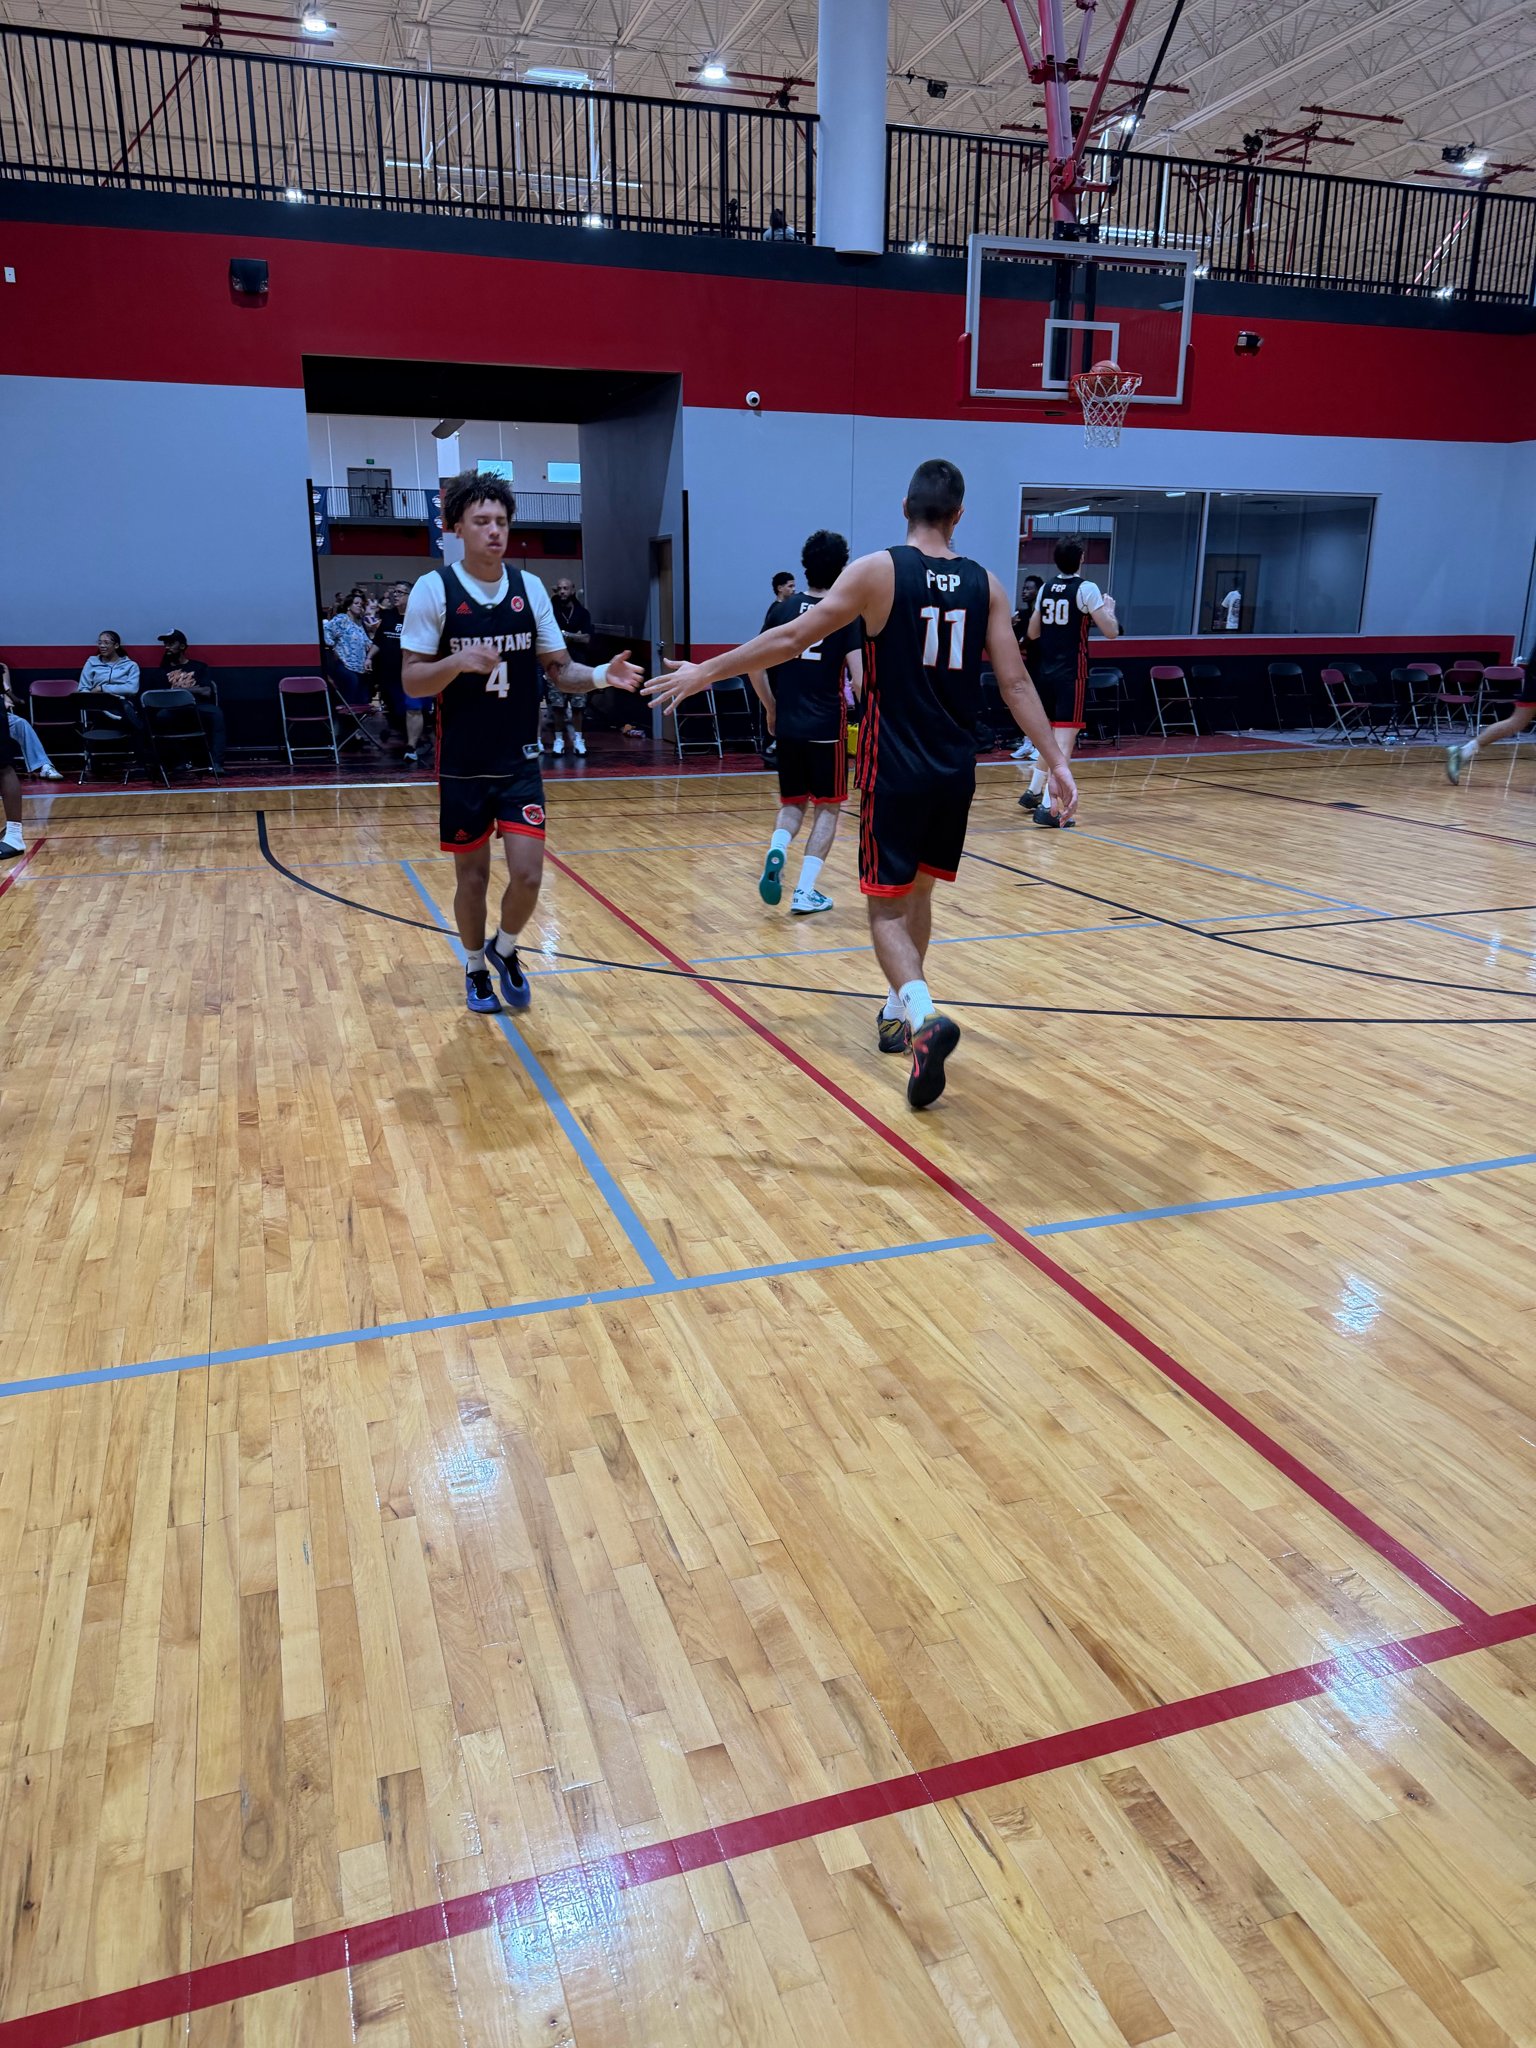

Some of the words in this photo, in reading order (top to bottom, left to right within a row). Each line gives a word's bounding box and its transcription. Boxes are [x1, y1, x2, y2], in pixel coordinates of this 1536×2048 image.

[926, 569, 961, 592] FCP
[1050, 583, 1067, 593] FCP
[799, 602, 816, 614] FC
[1041, 598, 1070, 625] 30
[920, 605, 967, 670] 11
[485, 661, 510, 698] 4
